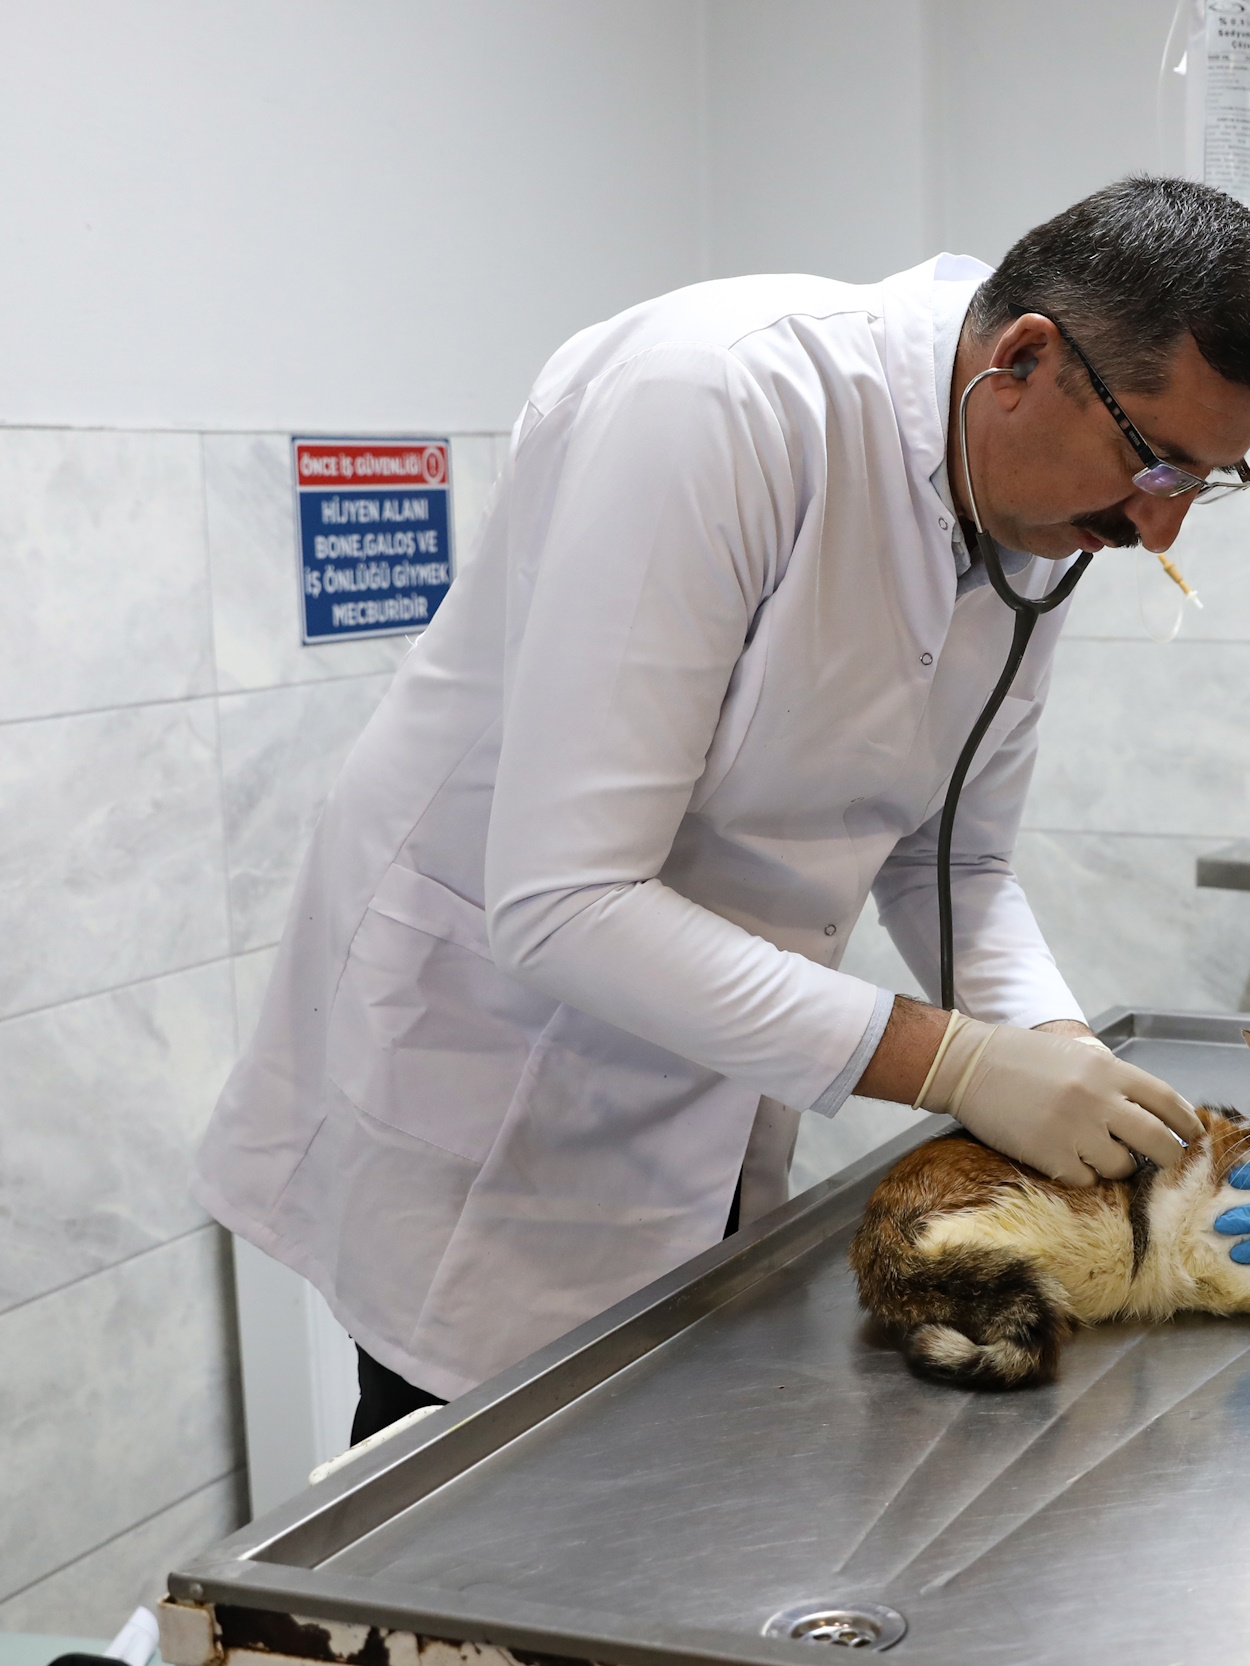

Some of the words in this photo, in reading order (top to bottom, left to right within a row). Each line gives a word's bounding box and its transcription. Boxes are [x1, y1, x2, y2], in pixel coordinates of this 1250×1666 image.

[301, 451, 338, 477] ÖNCE
[339, 452, 354, 479] İŞ
[321, 495, 380, 525] HİJYEN
[382, 498, 429, 522] ALANI
[314, 531, 417, 561] BONE,GALOŞ
[417, 530, 439, 554] VE
[304, 565, 322, 599] İŞ
[322, 561, 391, 594] ÖNLÜĞÜ
[392, 560, 449, 588] GİYMEK
[333, 593, 427, 627] MECBURİDİR
